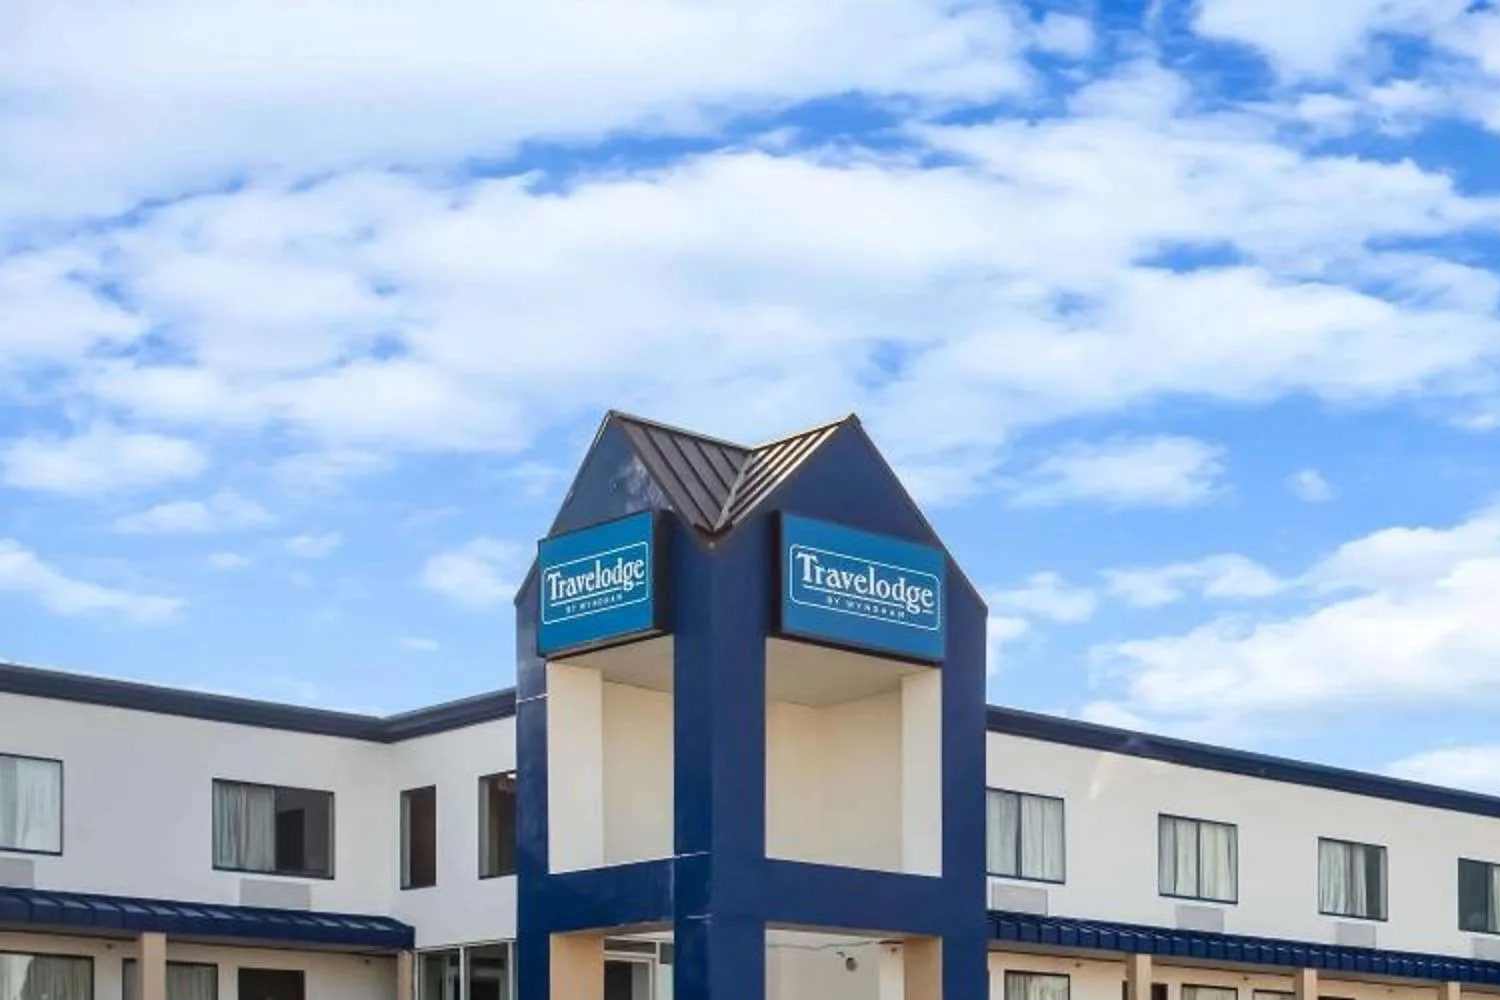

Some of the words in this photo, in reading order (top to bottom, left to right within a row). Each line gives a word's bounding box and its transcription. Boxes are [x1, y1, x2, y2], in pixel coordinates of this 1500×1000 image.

[547, 556, 645, 601] Travelodge
[795, 551, 934, 614] Travelodge
[827, 596, 841, 605] BY
[847, 599, 905, 618] WYNDHAM
